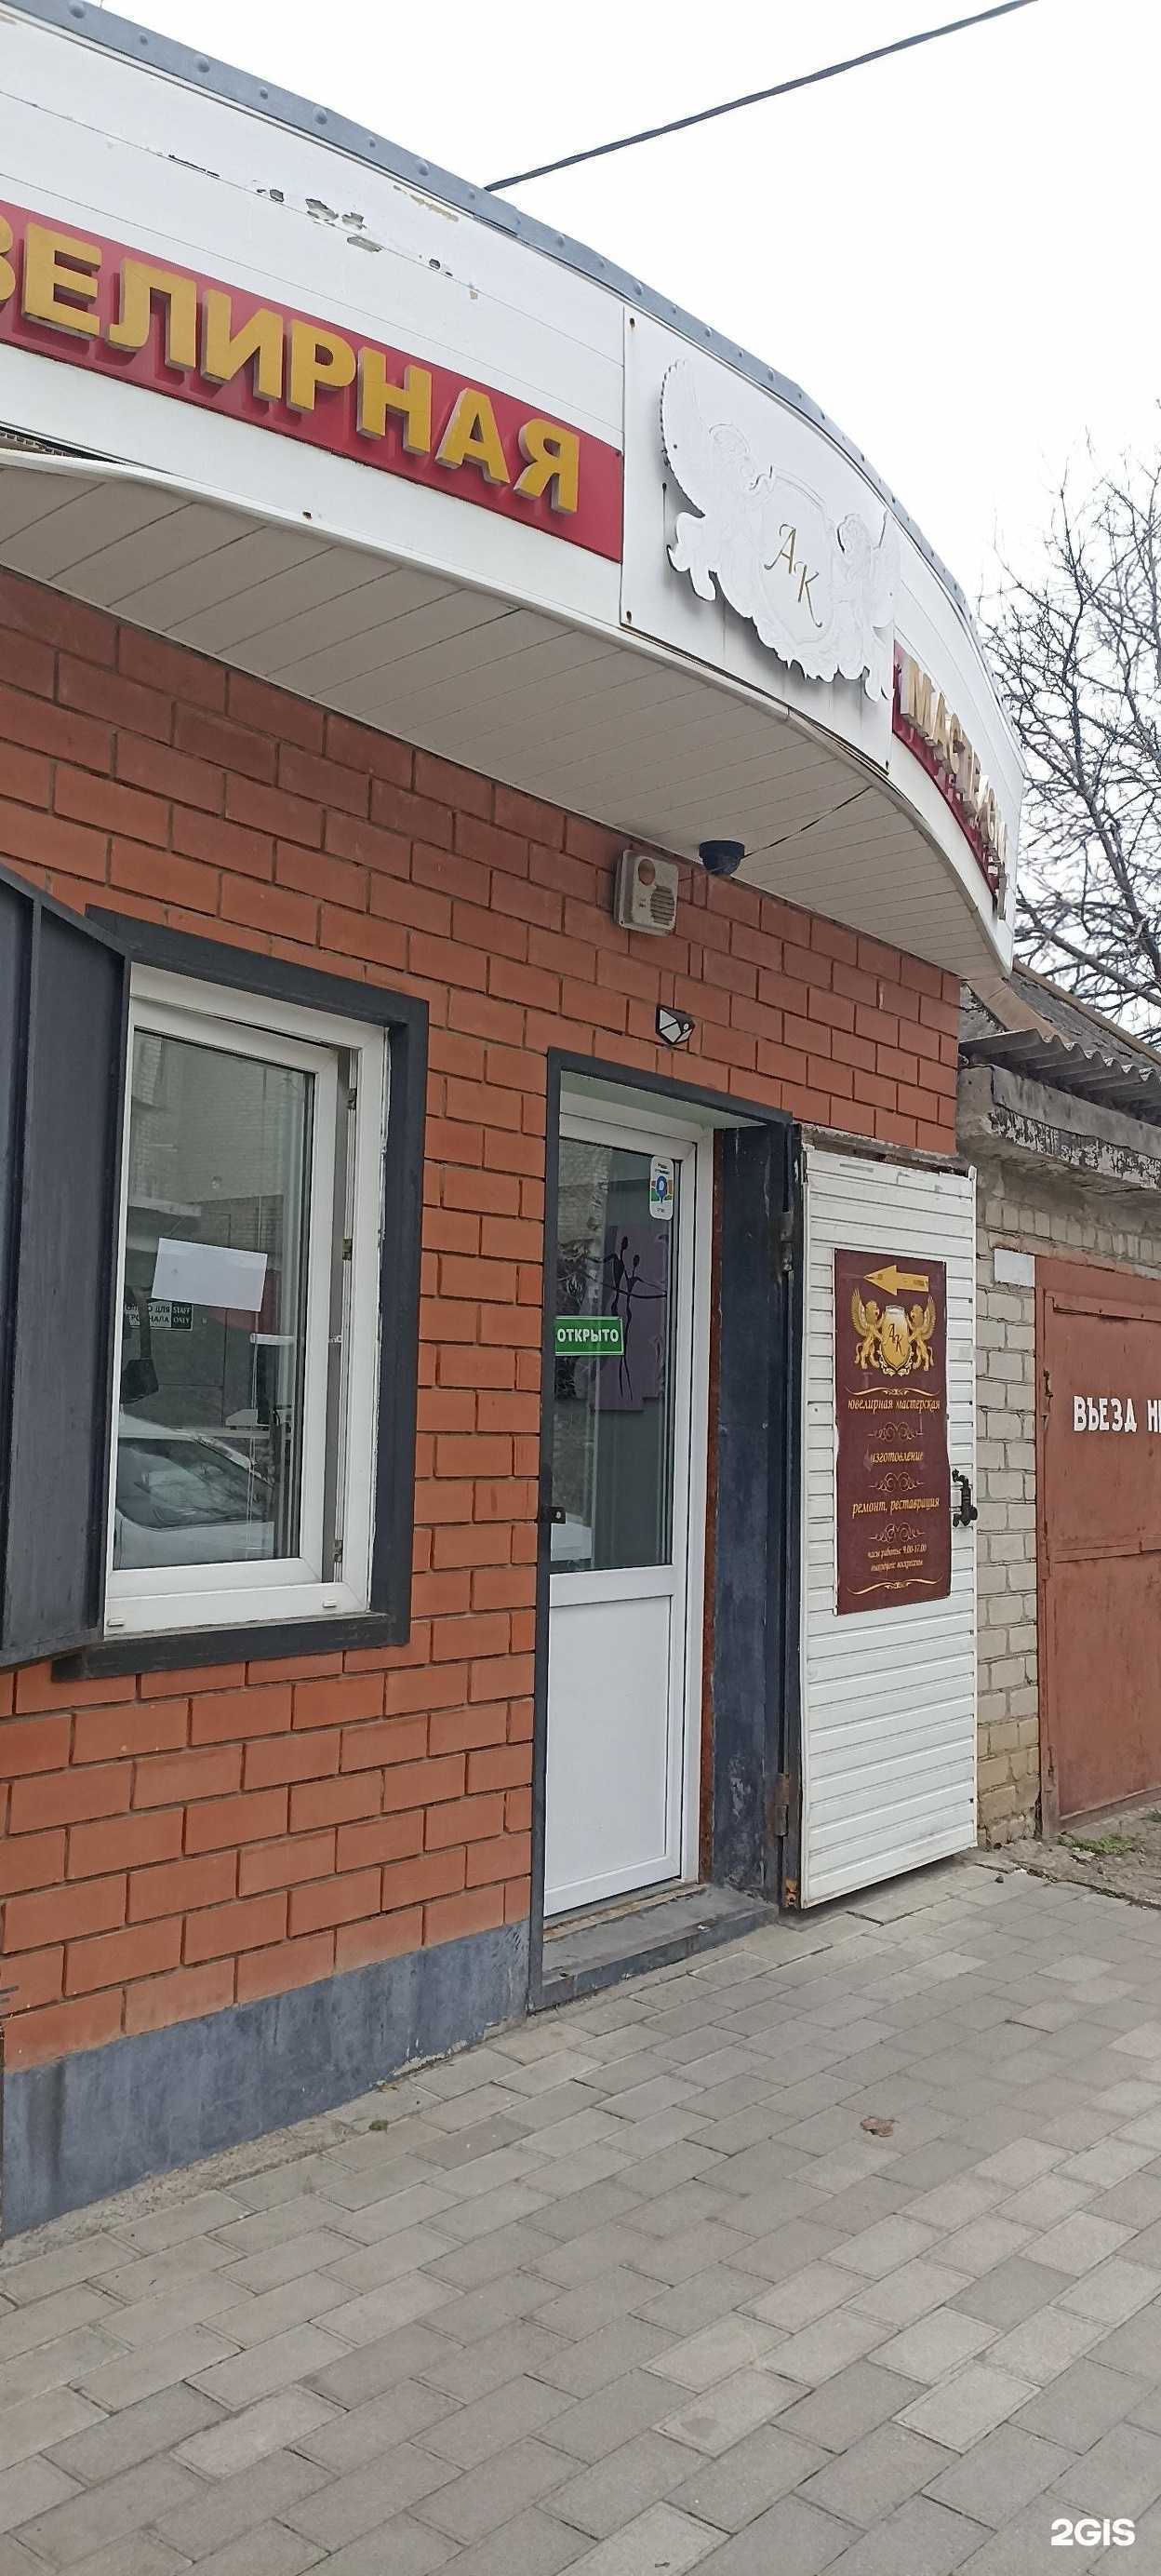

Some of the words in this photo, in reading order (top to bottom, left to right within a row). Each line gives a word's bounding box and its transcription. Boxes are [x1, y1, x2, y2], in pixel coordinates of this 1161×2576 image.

[0, 215, 580, 515] ЕЛИРНАЯ
[556, 1328, 620, 1344] ОТКРЫТО
[847, 1400, 893, 1415] ювелирная
[896, 1399, 941, 1415] мастерская
[1073, 1395, 1138, 1433] ВЪЕЗД
[870, 1451, 924, 1463] изготовление
[889, 1497, 940, 1516] реставрация
